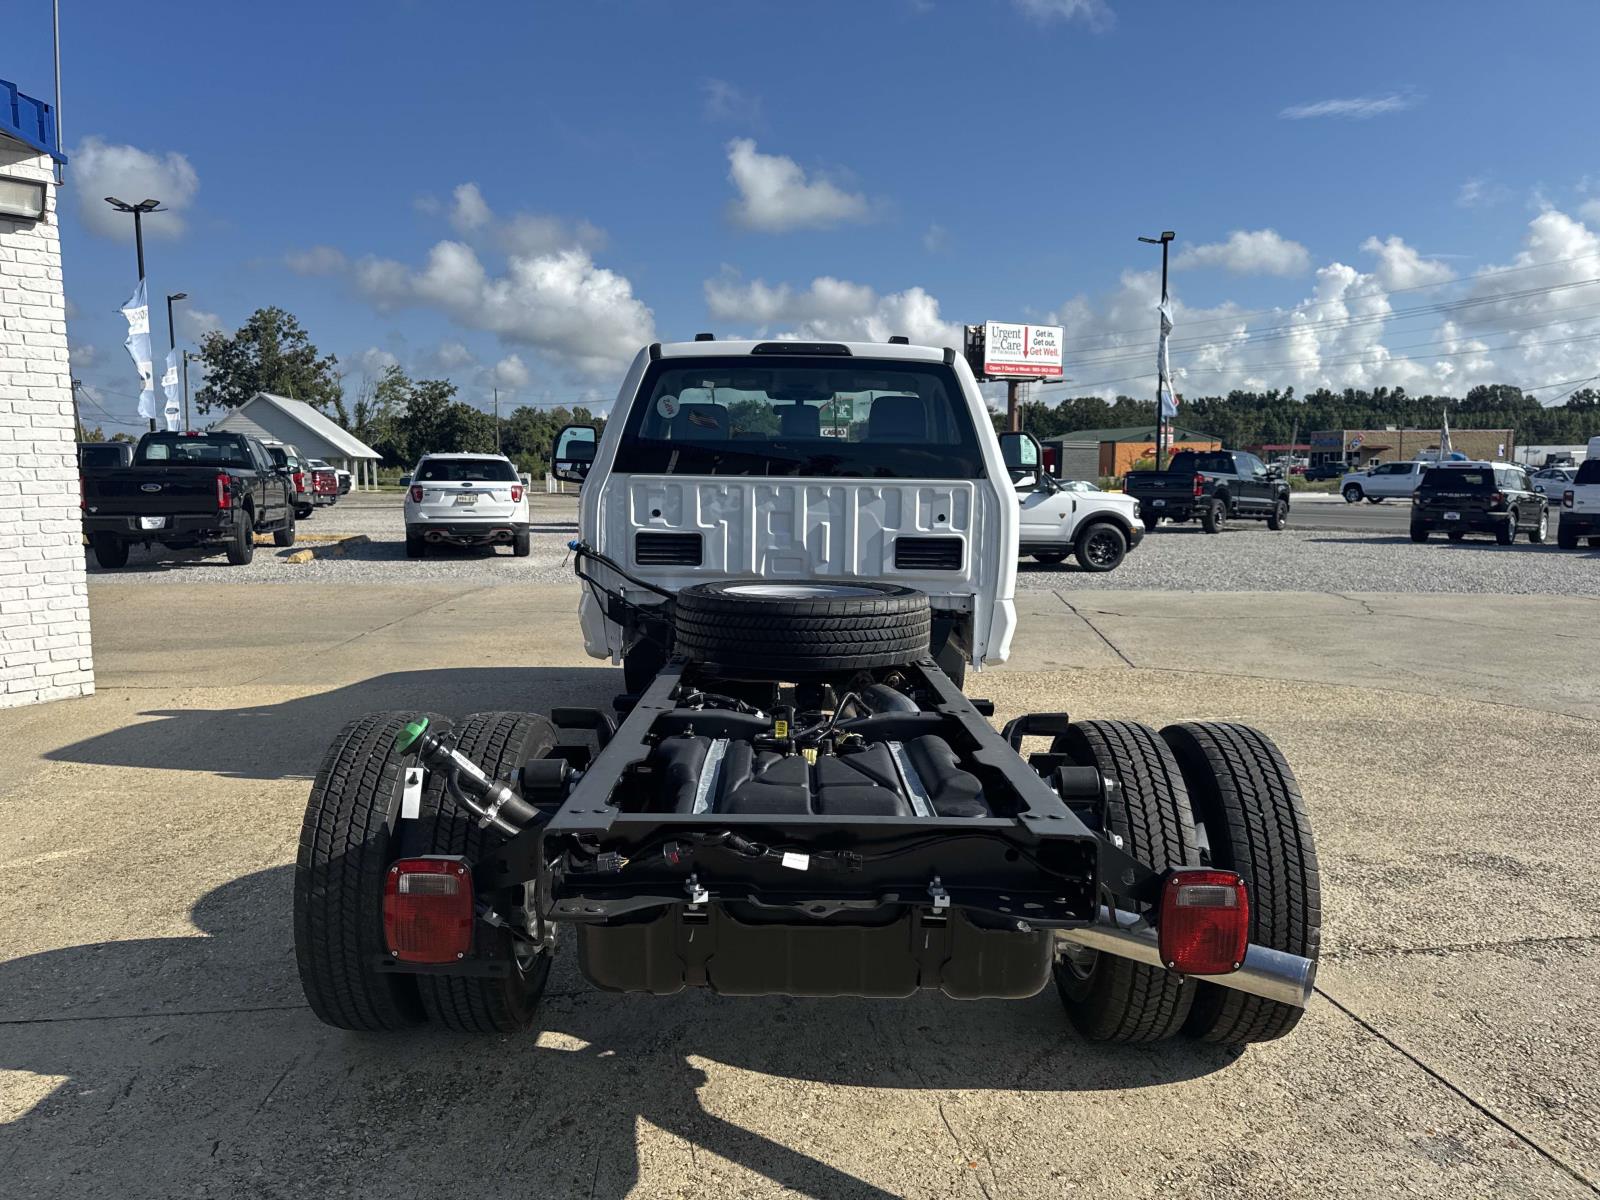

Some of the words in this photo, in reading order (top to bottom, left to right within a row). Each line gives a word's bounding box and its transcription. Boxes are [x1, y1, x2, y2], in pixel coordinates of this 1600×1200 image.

[992, 326, 1021, 341] Urgent
[1035, 329, 1046, 337] Get
[1000, 337, 1021, 350] Care
[1033, 338, 1044, 346] Get
[1030, 347, 1042, 356] Get
